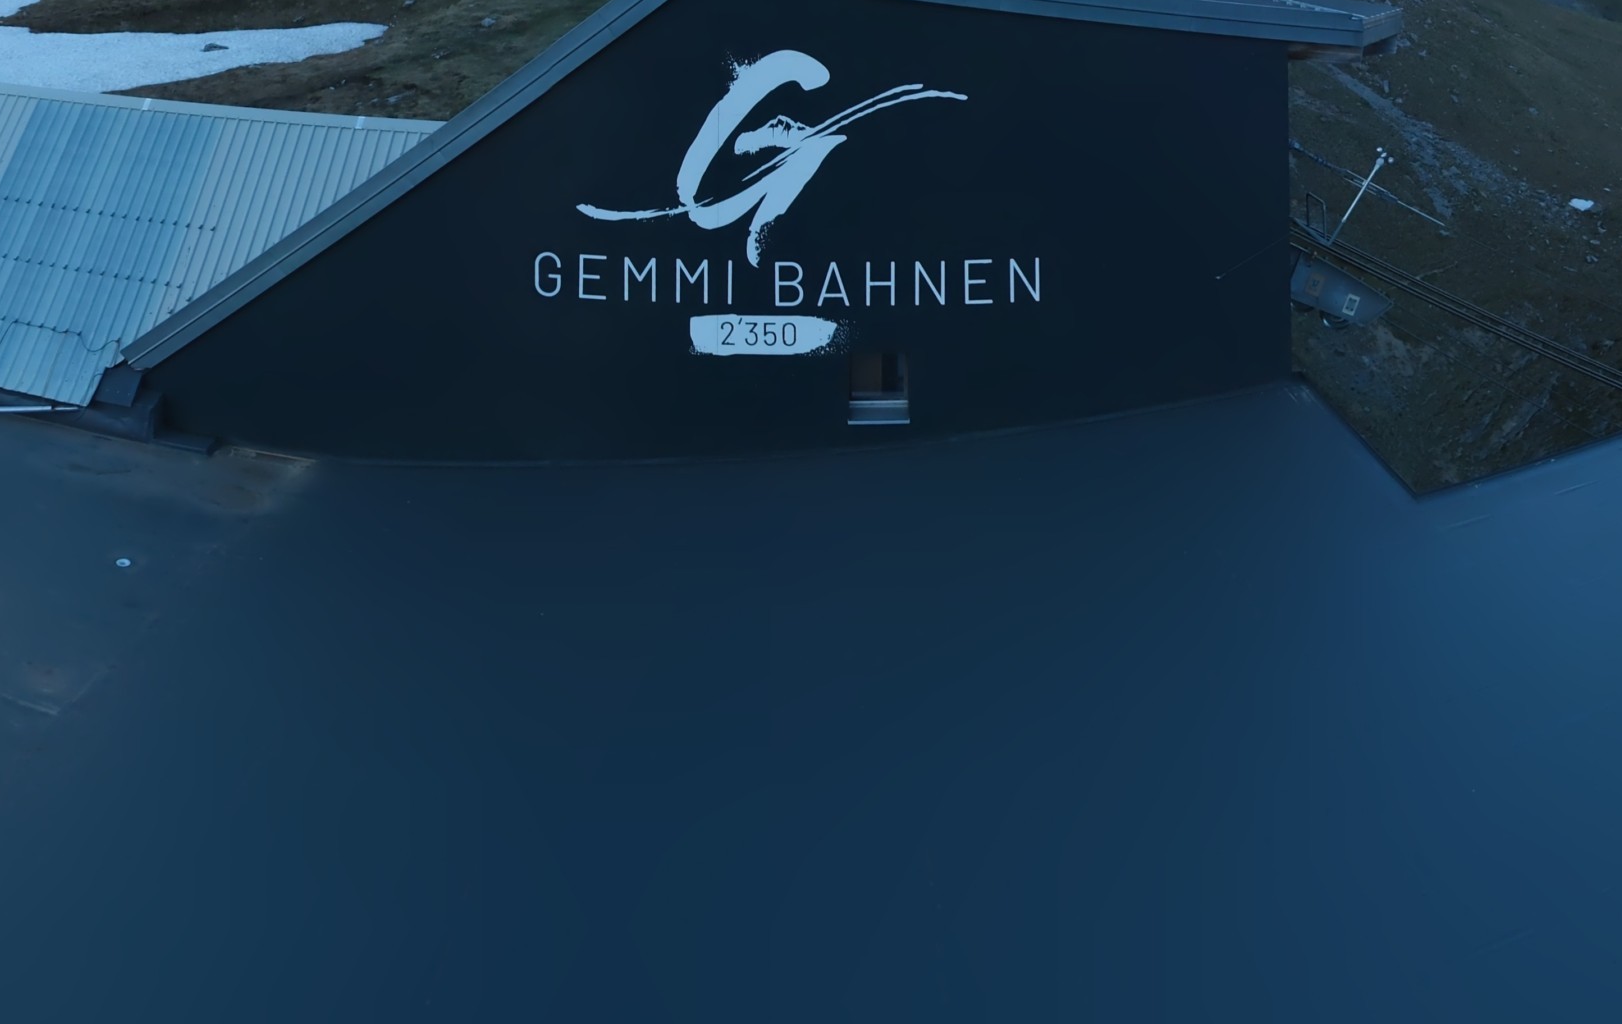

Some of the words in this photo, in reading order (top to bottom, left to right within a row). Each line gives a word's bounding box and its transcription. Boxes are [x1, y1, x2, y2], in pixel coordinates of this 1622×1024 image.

[534, 251, 734, 306] GEMMI
[773, 257, 1041, 308] BAHNEN
[720, 317, 797, 347] 2'350
